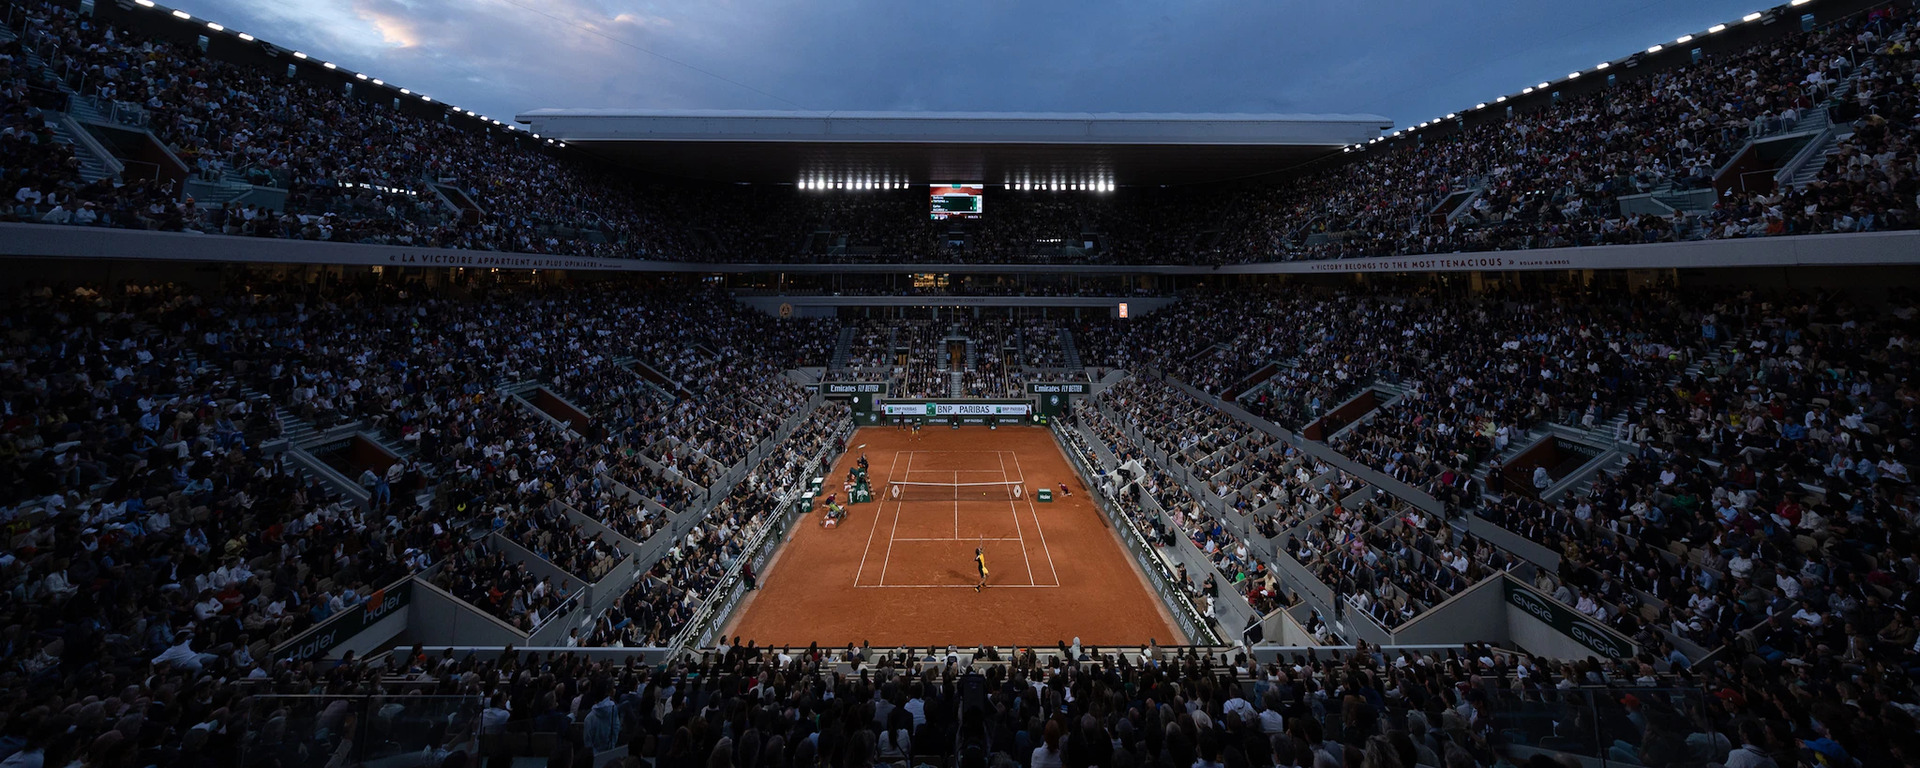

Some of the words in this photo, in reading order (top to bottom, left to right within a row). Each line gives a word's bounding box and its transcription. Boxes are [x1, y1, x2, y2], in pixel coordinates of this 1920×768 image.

[402, 254, 415, 262] LA
[422, 254, 472, 264] VICTOIRE
[478, 257, 530, 266] APPARTIENT
[1412, 260, 1435, 268] MOST
[1440, 258, 1502, 267] TENACIOUS
[363, 593, 402, 624] Haier
[289, 629, 336, 660] Haier
